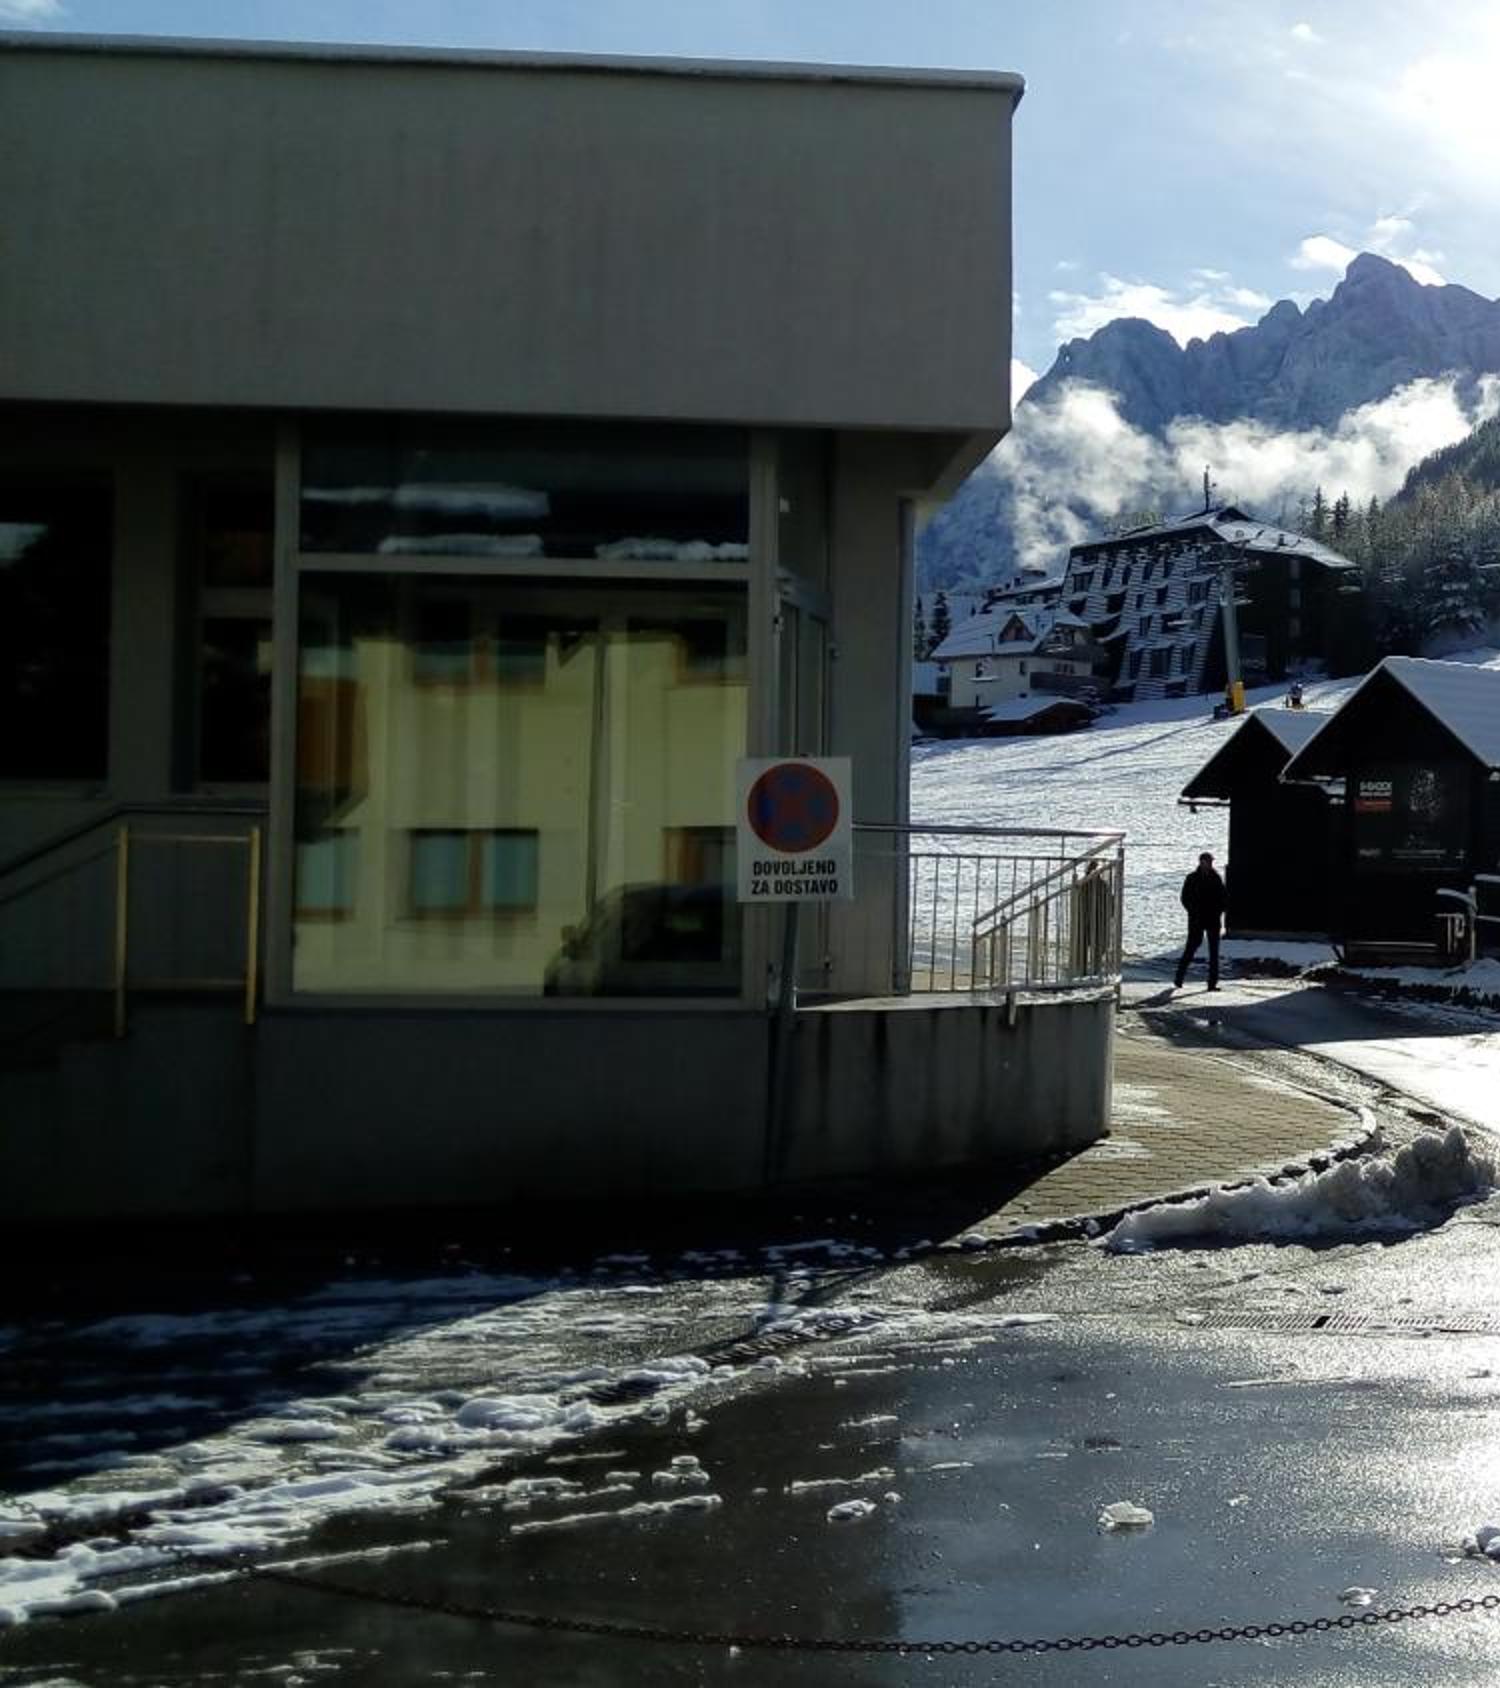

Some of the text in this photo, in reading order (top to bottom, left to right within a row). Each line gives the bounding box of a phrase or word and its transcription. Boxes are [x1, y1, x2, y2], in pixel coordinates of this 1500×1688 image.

[753, 860, 837, 876] DOVOLJENO
[751, 879, 839, 895] ZA DOSTAVO
